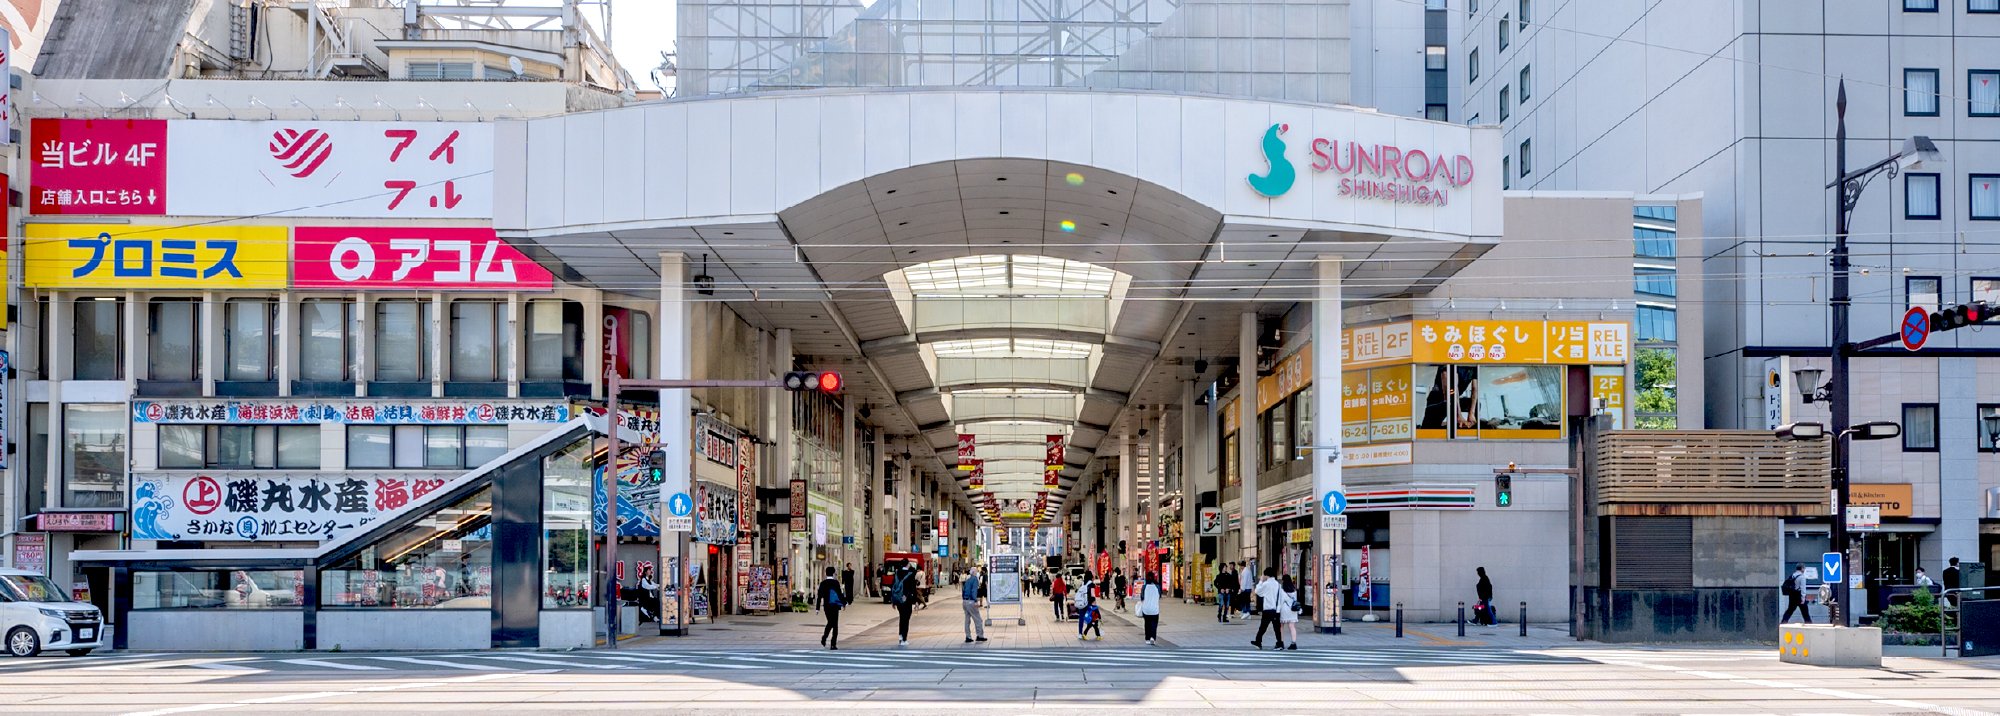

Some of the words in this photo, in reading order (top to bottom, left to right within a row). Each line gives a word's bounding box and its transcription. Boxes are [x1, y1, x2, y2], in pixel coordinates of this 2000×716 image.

[385, 129, 461, 164] アイ
[41, 143, 117, 169] 当ビル
[125, 144, 156, 167] 4F
[1312, 137, 1474, 187] SUNROAD
[40, 189, 142, 205] 店舗入口こちら
[385, 180, 462, 211] フル
[1340, 177, 1449, 206] SHINSHIGAI
[69, 231, 243, 279] プロミス
[390, 239, 516, 282] アコム
[1357, 332, 1378, 344] REL
[1387, 332, 1408, 349] 2F
[1421, 325, 1530, 343] もみほぐし
[1594, 330, 1623, 342] REL
[1357, 344, 1379, 357] XLE
[1594, 344, 1623, 357] XLE
[1343, 378, 1408, 396] もみほぐし
[1600, 377, 1618, 390] 2F
[164, 405, 226, 420] 磯丸水産
[307, 404, 336, 420] 刺身
[346, 405, 375, 420] 活魚
[383, 405, 413, 420] 活貝
[421, 405, 465, 420] 海鮮丼
[495, 405, 556, 421] 磯丸水産
[225, 478, 369, 513] 磯丸水産
[187, 518, 234, 535] さかな
[261, 518, 354, 536] 加工センター
